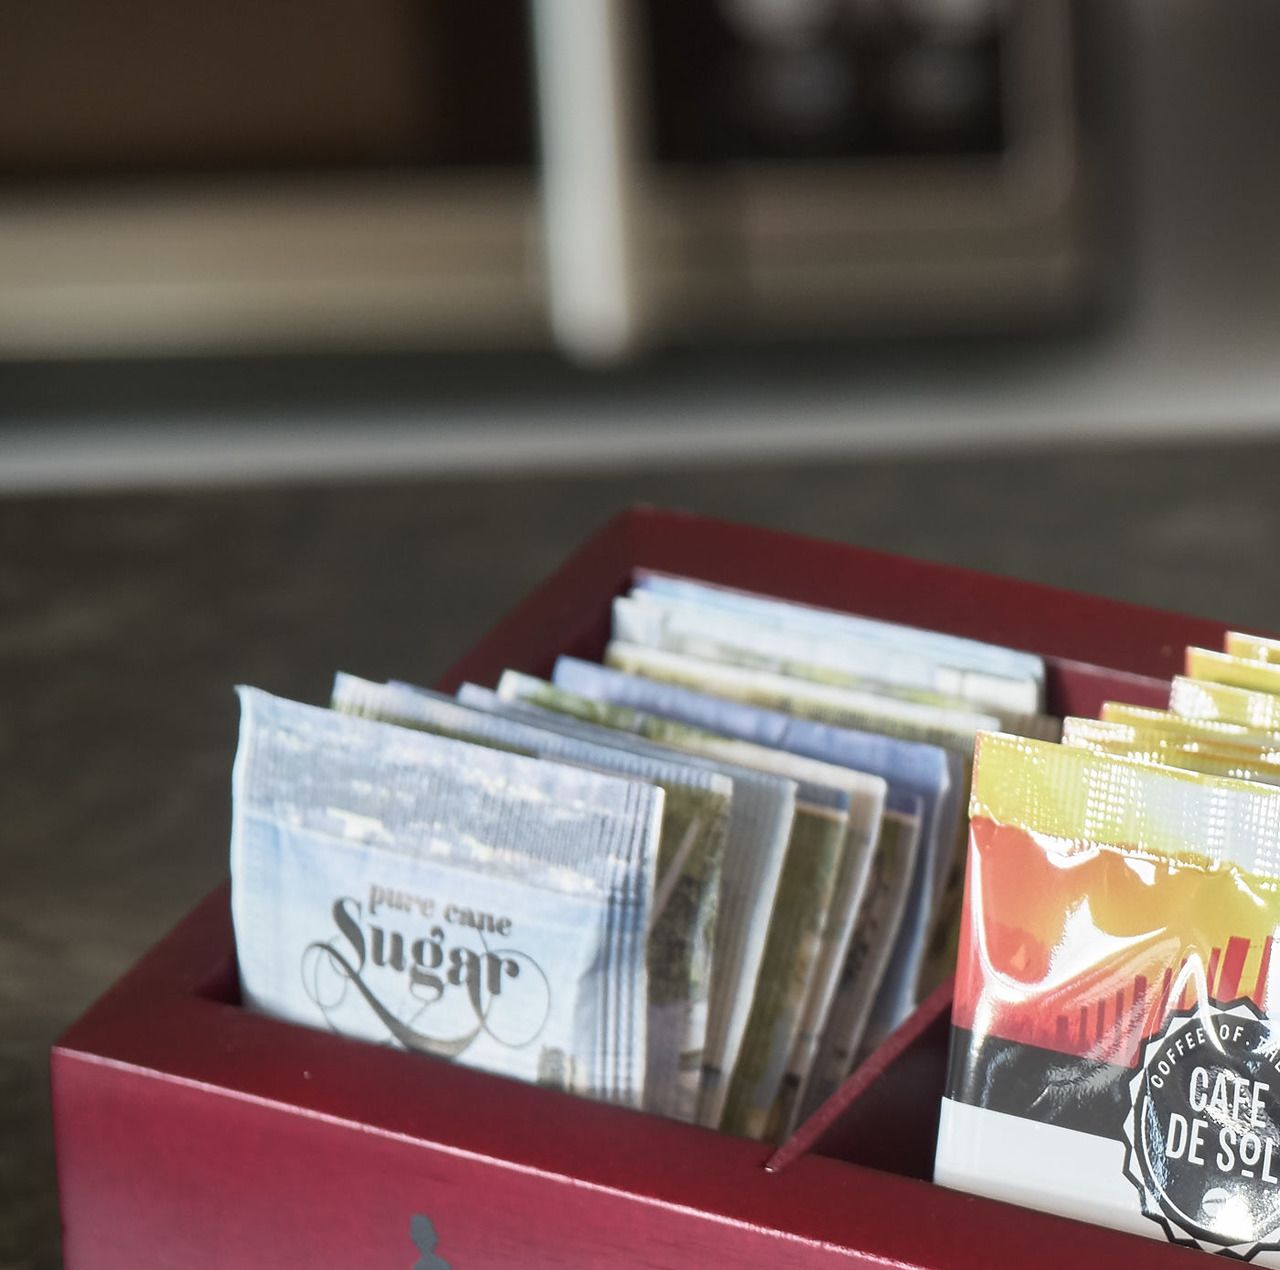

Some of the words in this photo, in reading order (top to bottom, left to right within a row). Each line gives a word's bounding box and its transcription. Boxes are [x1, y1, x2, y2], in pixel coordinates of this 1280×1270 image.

[368, 882, 436, 918] pure
[443, 902, 514, 937] cane
[310, 896, 525, 1045] Sugar
[1150, 1027, 1206, 1089] COFFEE
[1190, 1066, 1271, 1130] CAFE
[1165, 1113, 1209, 1166] DE
[1216, 1128, 1278, 1184] SOL
